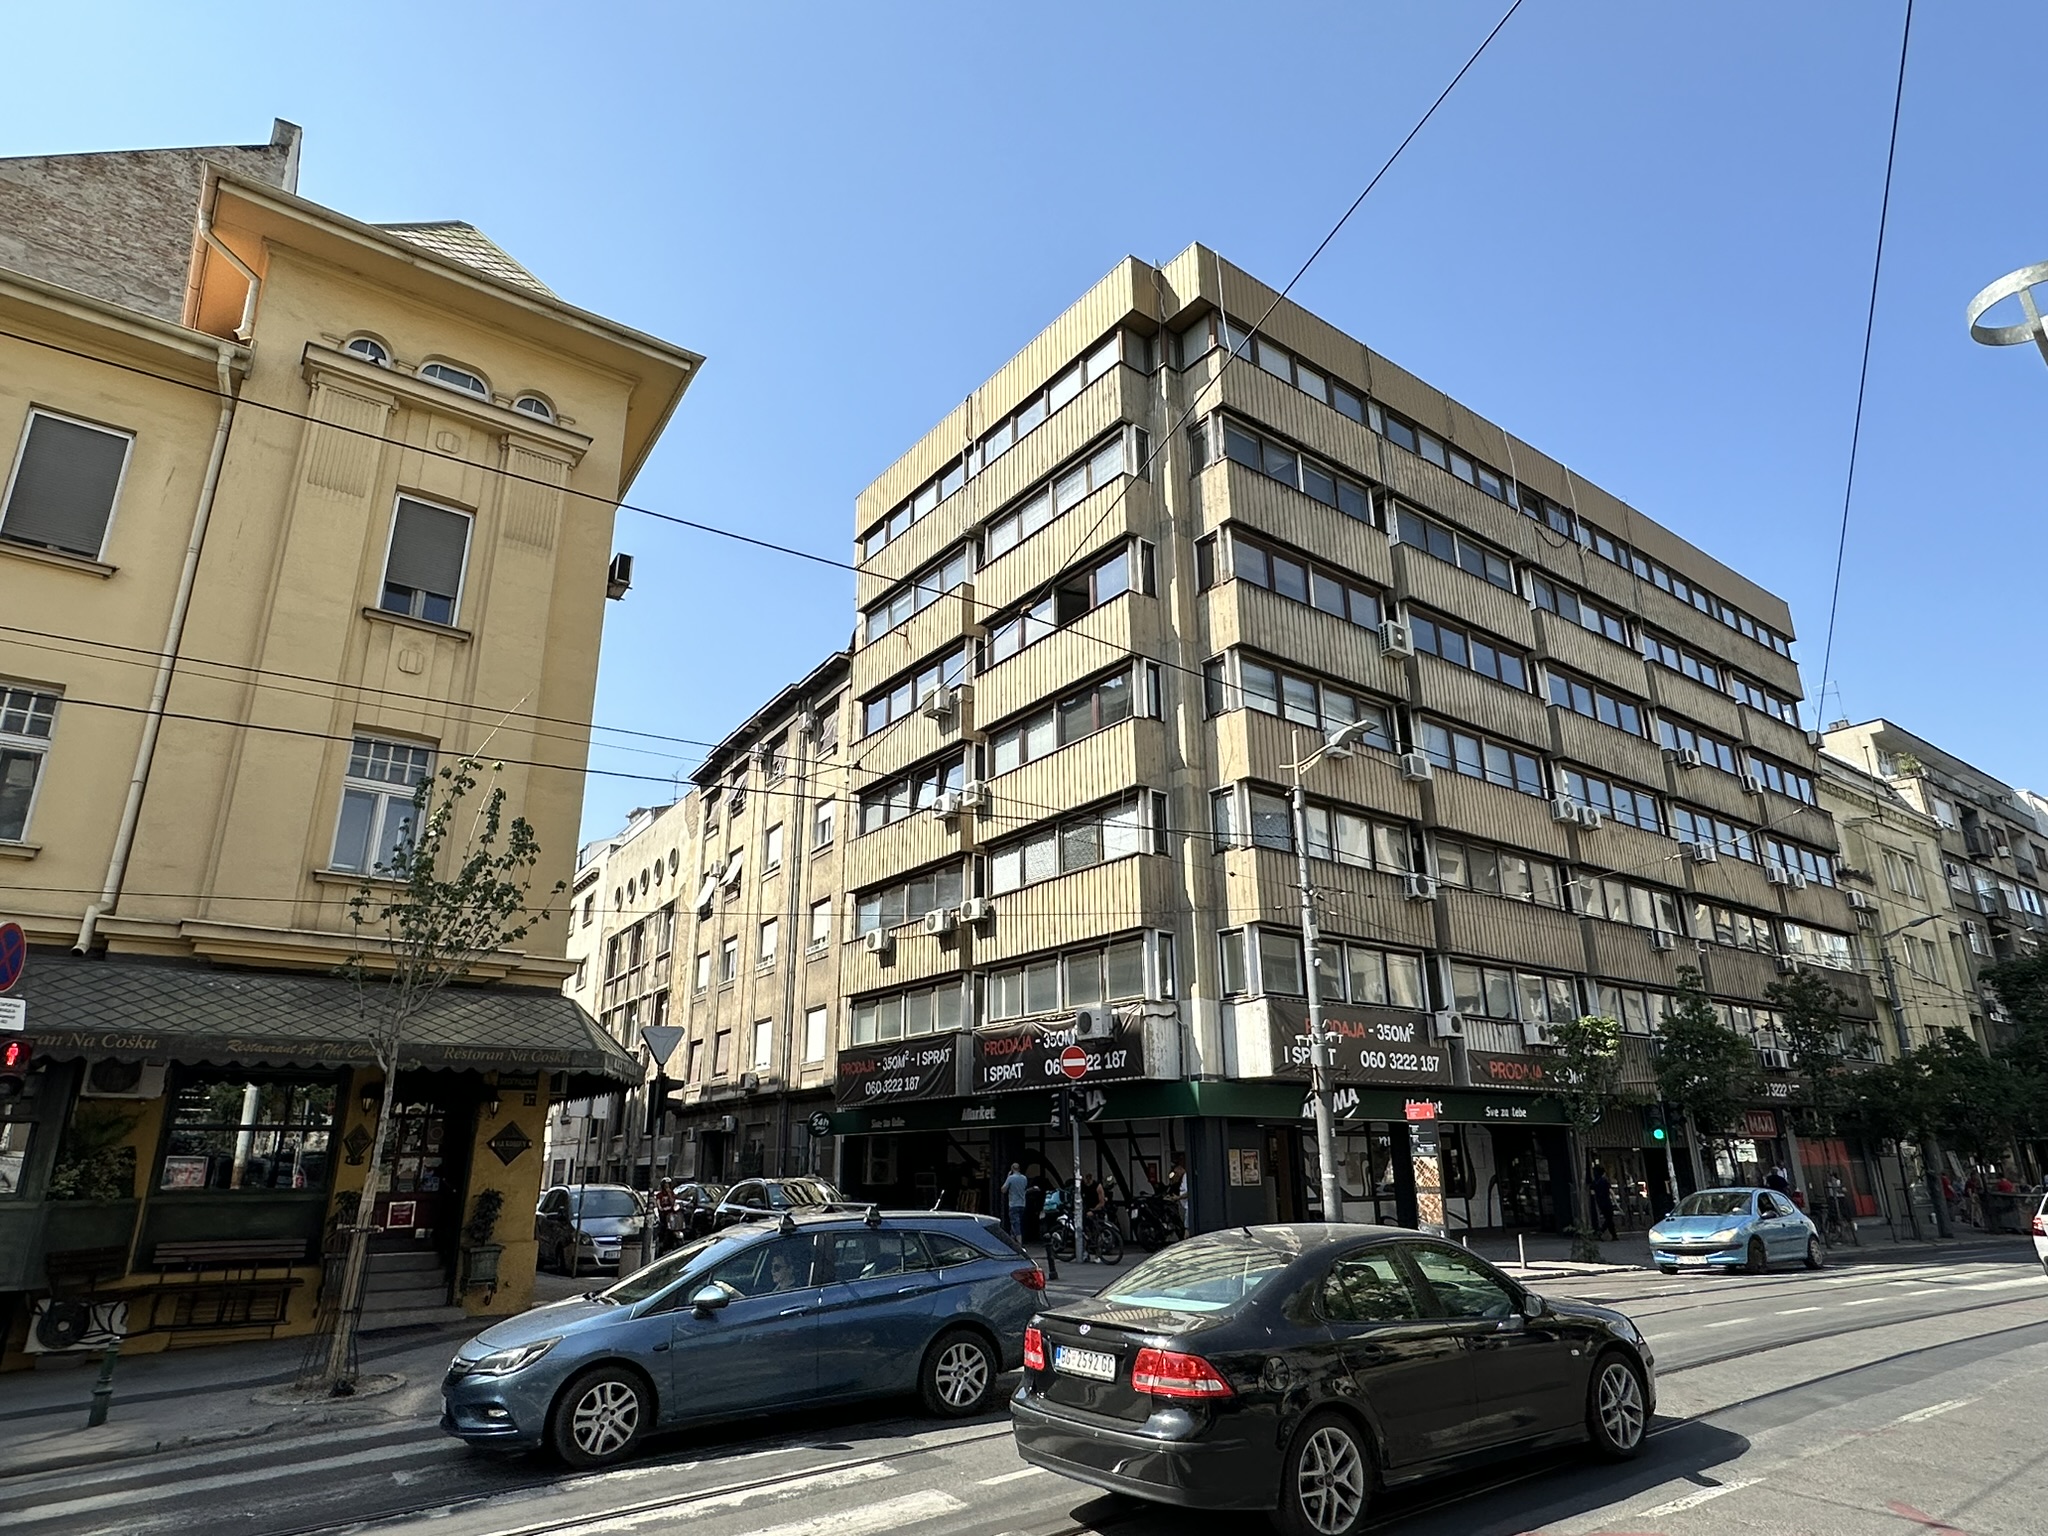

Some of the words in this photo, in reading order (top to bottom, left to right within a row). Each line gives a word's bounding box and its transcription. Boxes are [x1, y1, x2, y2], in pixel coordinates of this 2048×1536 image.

[1304, 1017, 1366, 1039] PODAJA
[67, 1032, 96, 1048] Na
[225, 1038, 297, 1055] Restaurant
[321, 1042, 345, 1057] The
[983, 1034, 1033, 1056] PRODAJA
[1043, 1028, 1078, 1050] 350M
[443, 1046, 504, 1062] Restoran
[841, 1059, 876, 1076] PRODAJA
[921, 1048, 952, 1066] SPRAT
[1291, 1046, 1336, 1066] SPT
[1360, 1053, 1386, 1070] 060
[1388, 1054, 1418, 1071] 3222
[1420, 1055, 1440, 1073] 187
[989, 1062, 1024, 1081] SPRAT
[1044, 1058, 1063, 1077] 06
[1105, 1050, 1128, 1070] 187
[865, 1079, 882, 1096] 060
[883, 1077, 903, 1094] 3222
[904, 1076, 920, 1091] 187
[812, 1117, 829, 1127] 24h
[961, 1105, 997, 1122] Market
[1485, 1106, 1498, 1118] Sve
[1500, 1108, 1510, 1118] za
[1511, 1106, 1527, 1119] tebe
[1748, 1113, 1775, 1133] MAXI
[1077, 1351, 1100, 1371] 2592
[1101, 1355, 1115, 1374] GC
